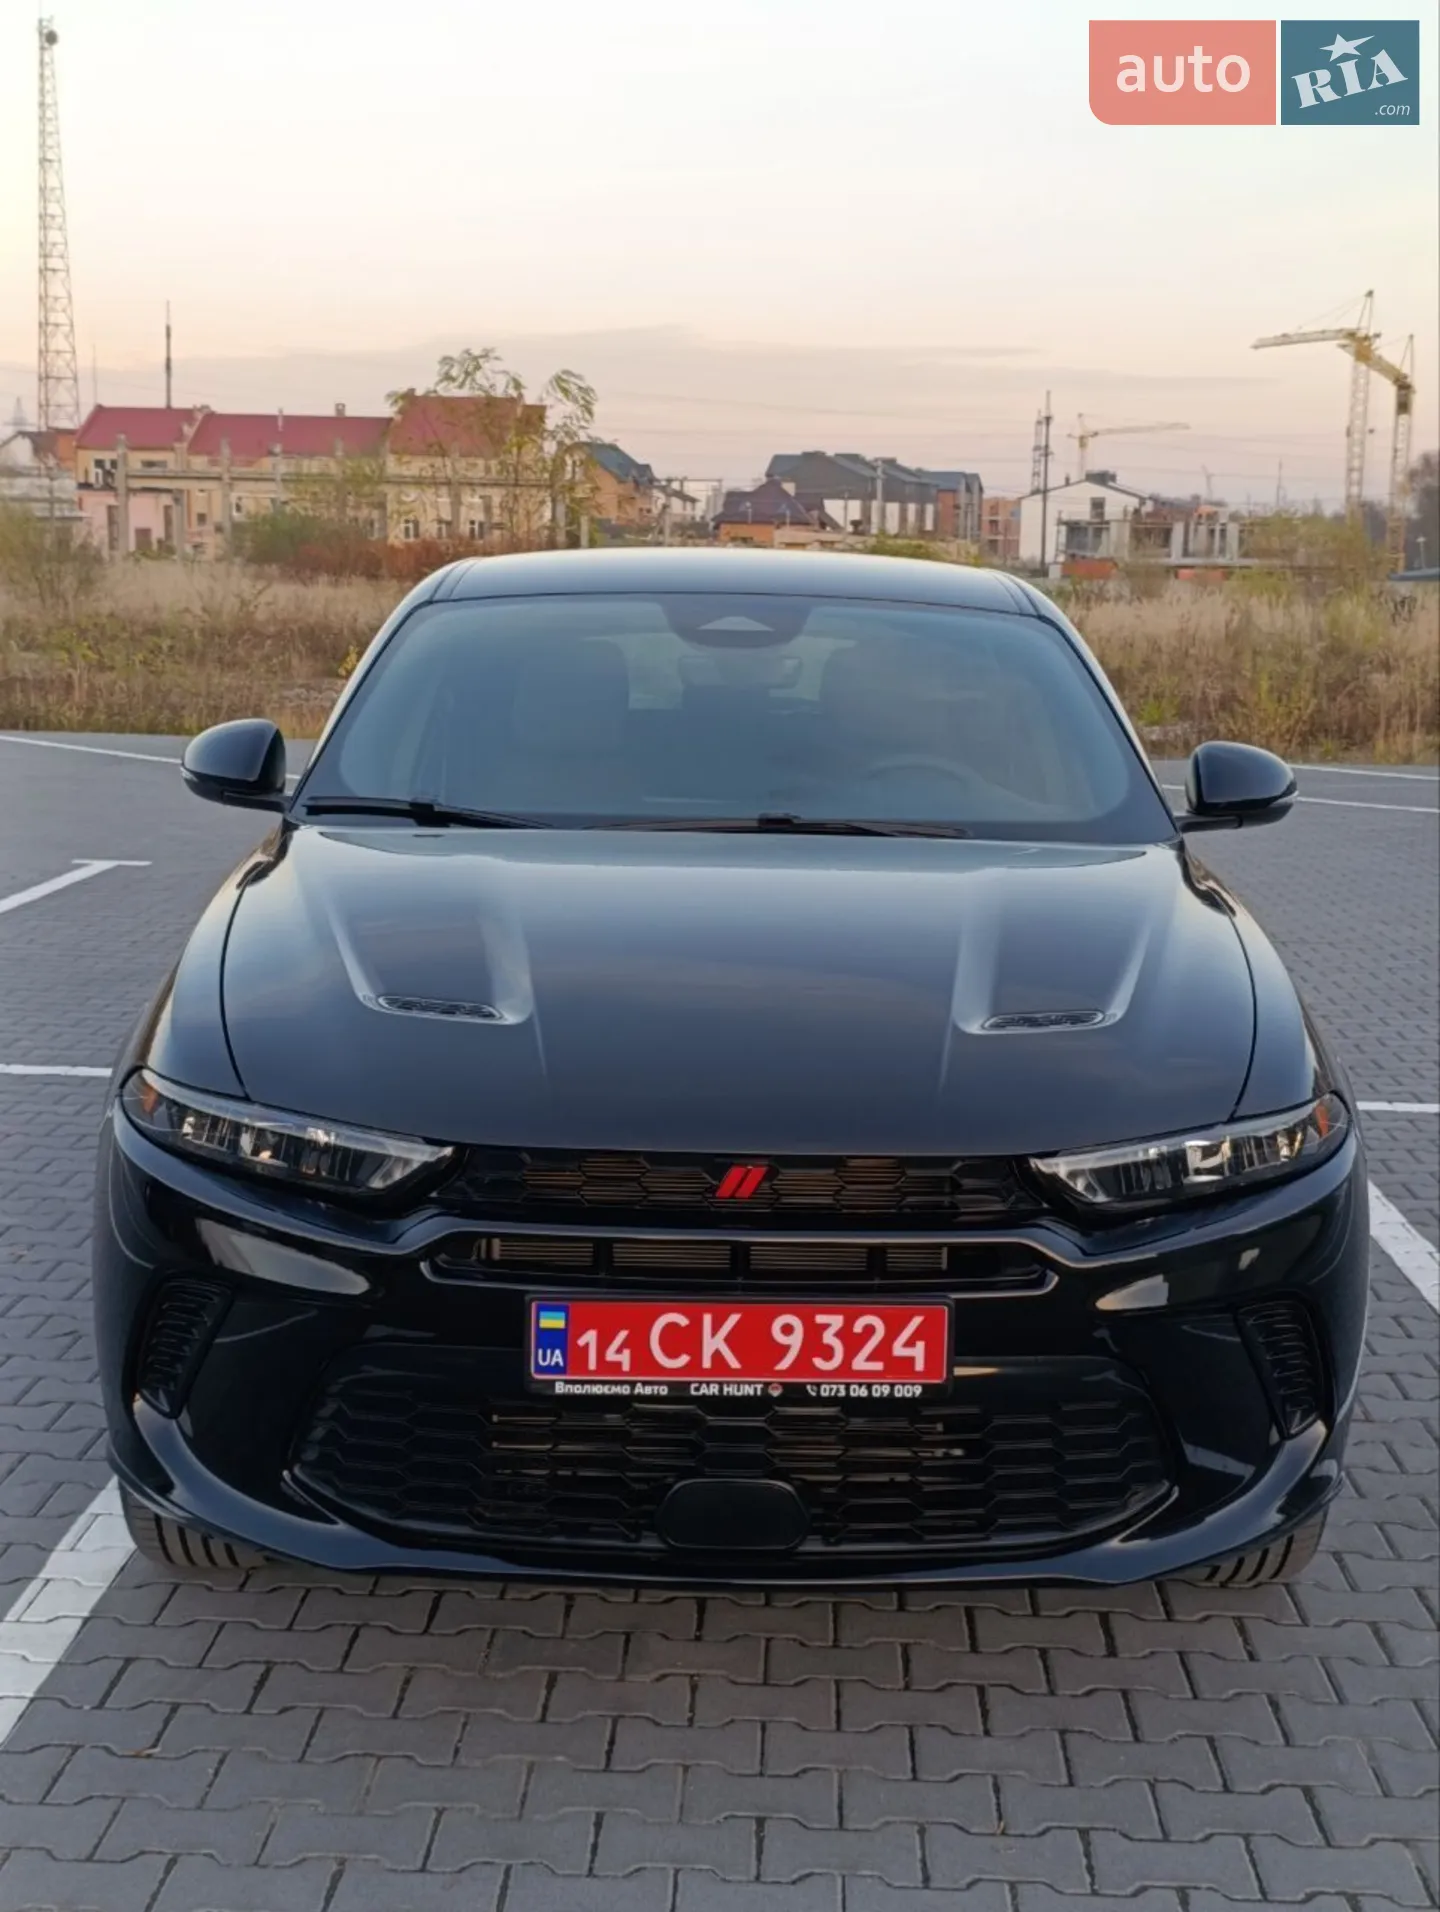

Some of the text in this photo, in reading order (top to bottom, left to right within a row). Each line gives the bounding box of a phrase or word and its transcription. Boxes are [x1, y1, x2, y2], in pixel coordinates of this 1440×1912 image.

[576, 1312, 926, 1372] 14 CK 9324
[538, 1348, 564, 1367] UA
[555, 1381, 668, 1396] Вполюємо Авто
[690, 1383, 763, 1397] CAR HUNT
[820, 1384, 922, 1398] 073 06 09 009
